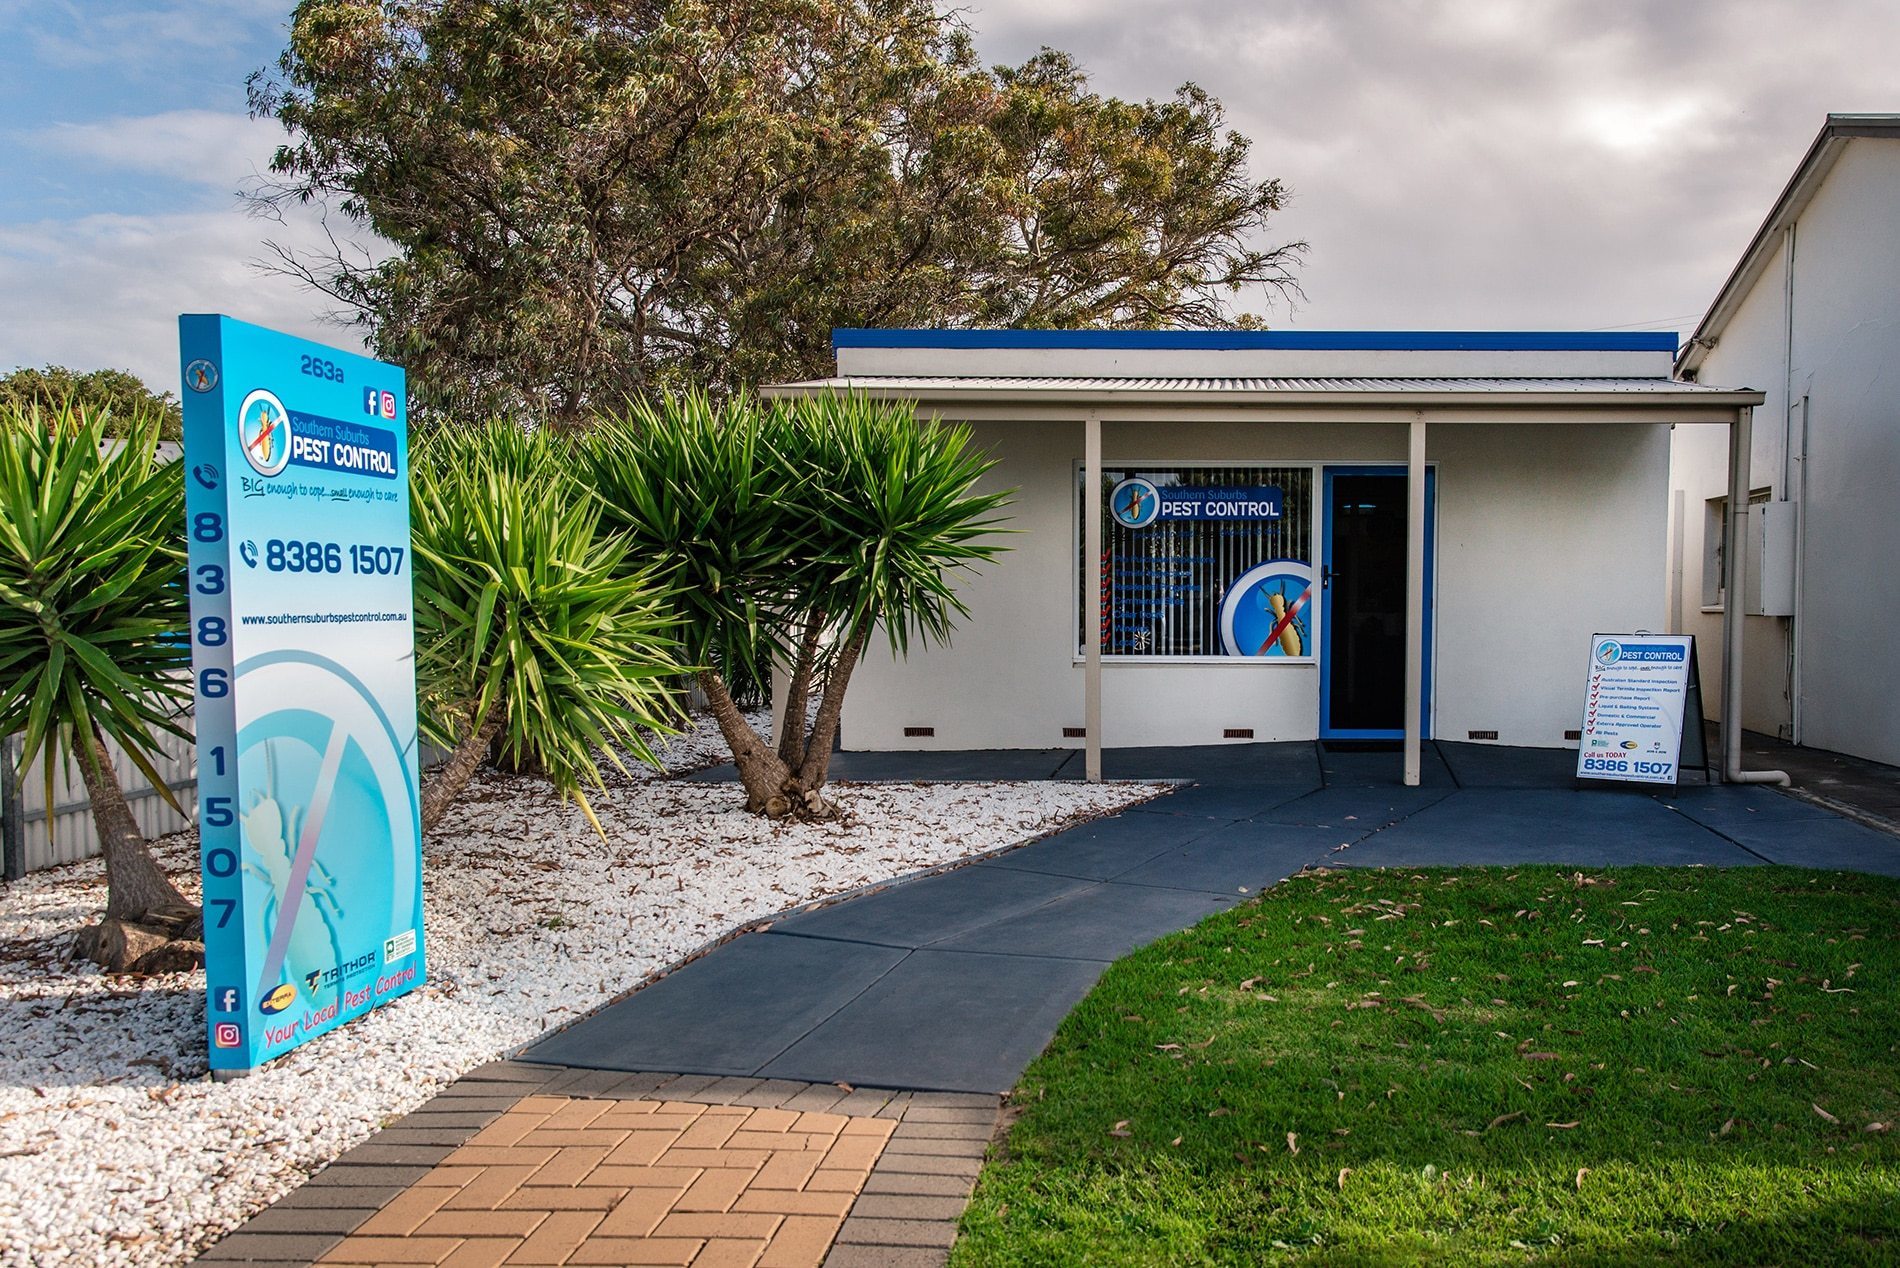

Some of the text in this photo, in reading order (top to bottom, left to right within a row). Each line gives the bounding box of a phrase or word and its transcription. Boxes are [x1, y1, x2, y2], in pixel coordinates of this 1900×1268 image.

[301, 354, 344, 383] 263a
[292, 416, 369, 445] Southern Suburbs
[293, 436, 396, 474] PEST CONTROL
[241, 476, 266, 497] BIG
[267, 482, 297, 500] enough
[300, 484, 308, 494] to
[349, 487, 374, 503] enough
[375, 490, 383, 501] to
[384, 492, 398, 502] care
[1161, 490, 1248, 500] Southern Suburbs
[1162, 502, 1279, 516] PEST CONTROL
[266, 539, 404, 575] 8386 1507
[241, 612, 407, 624] www.southernsuburbspestcontrol.com.au
[1622, 651, 1682, 660] PEST CONTROL
[1584, 758, 1672, 775] 8386 1507
[322, 952, 376, 983] TRITHOR
[265, 960, 416, 1048] Your Local Pest Control
